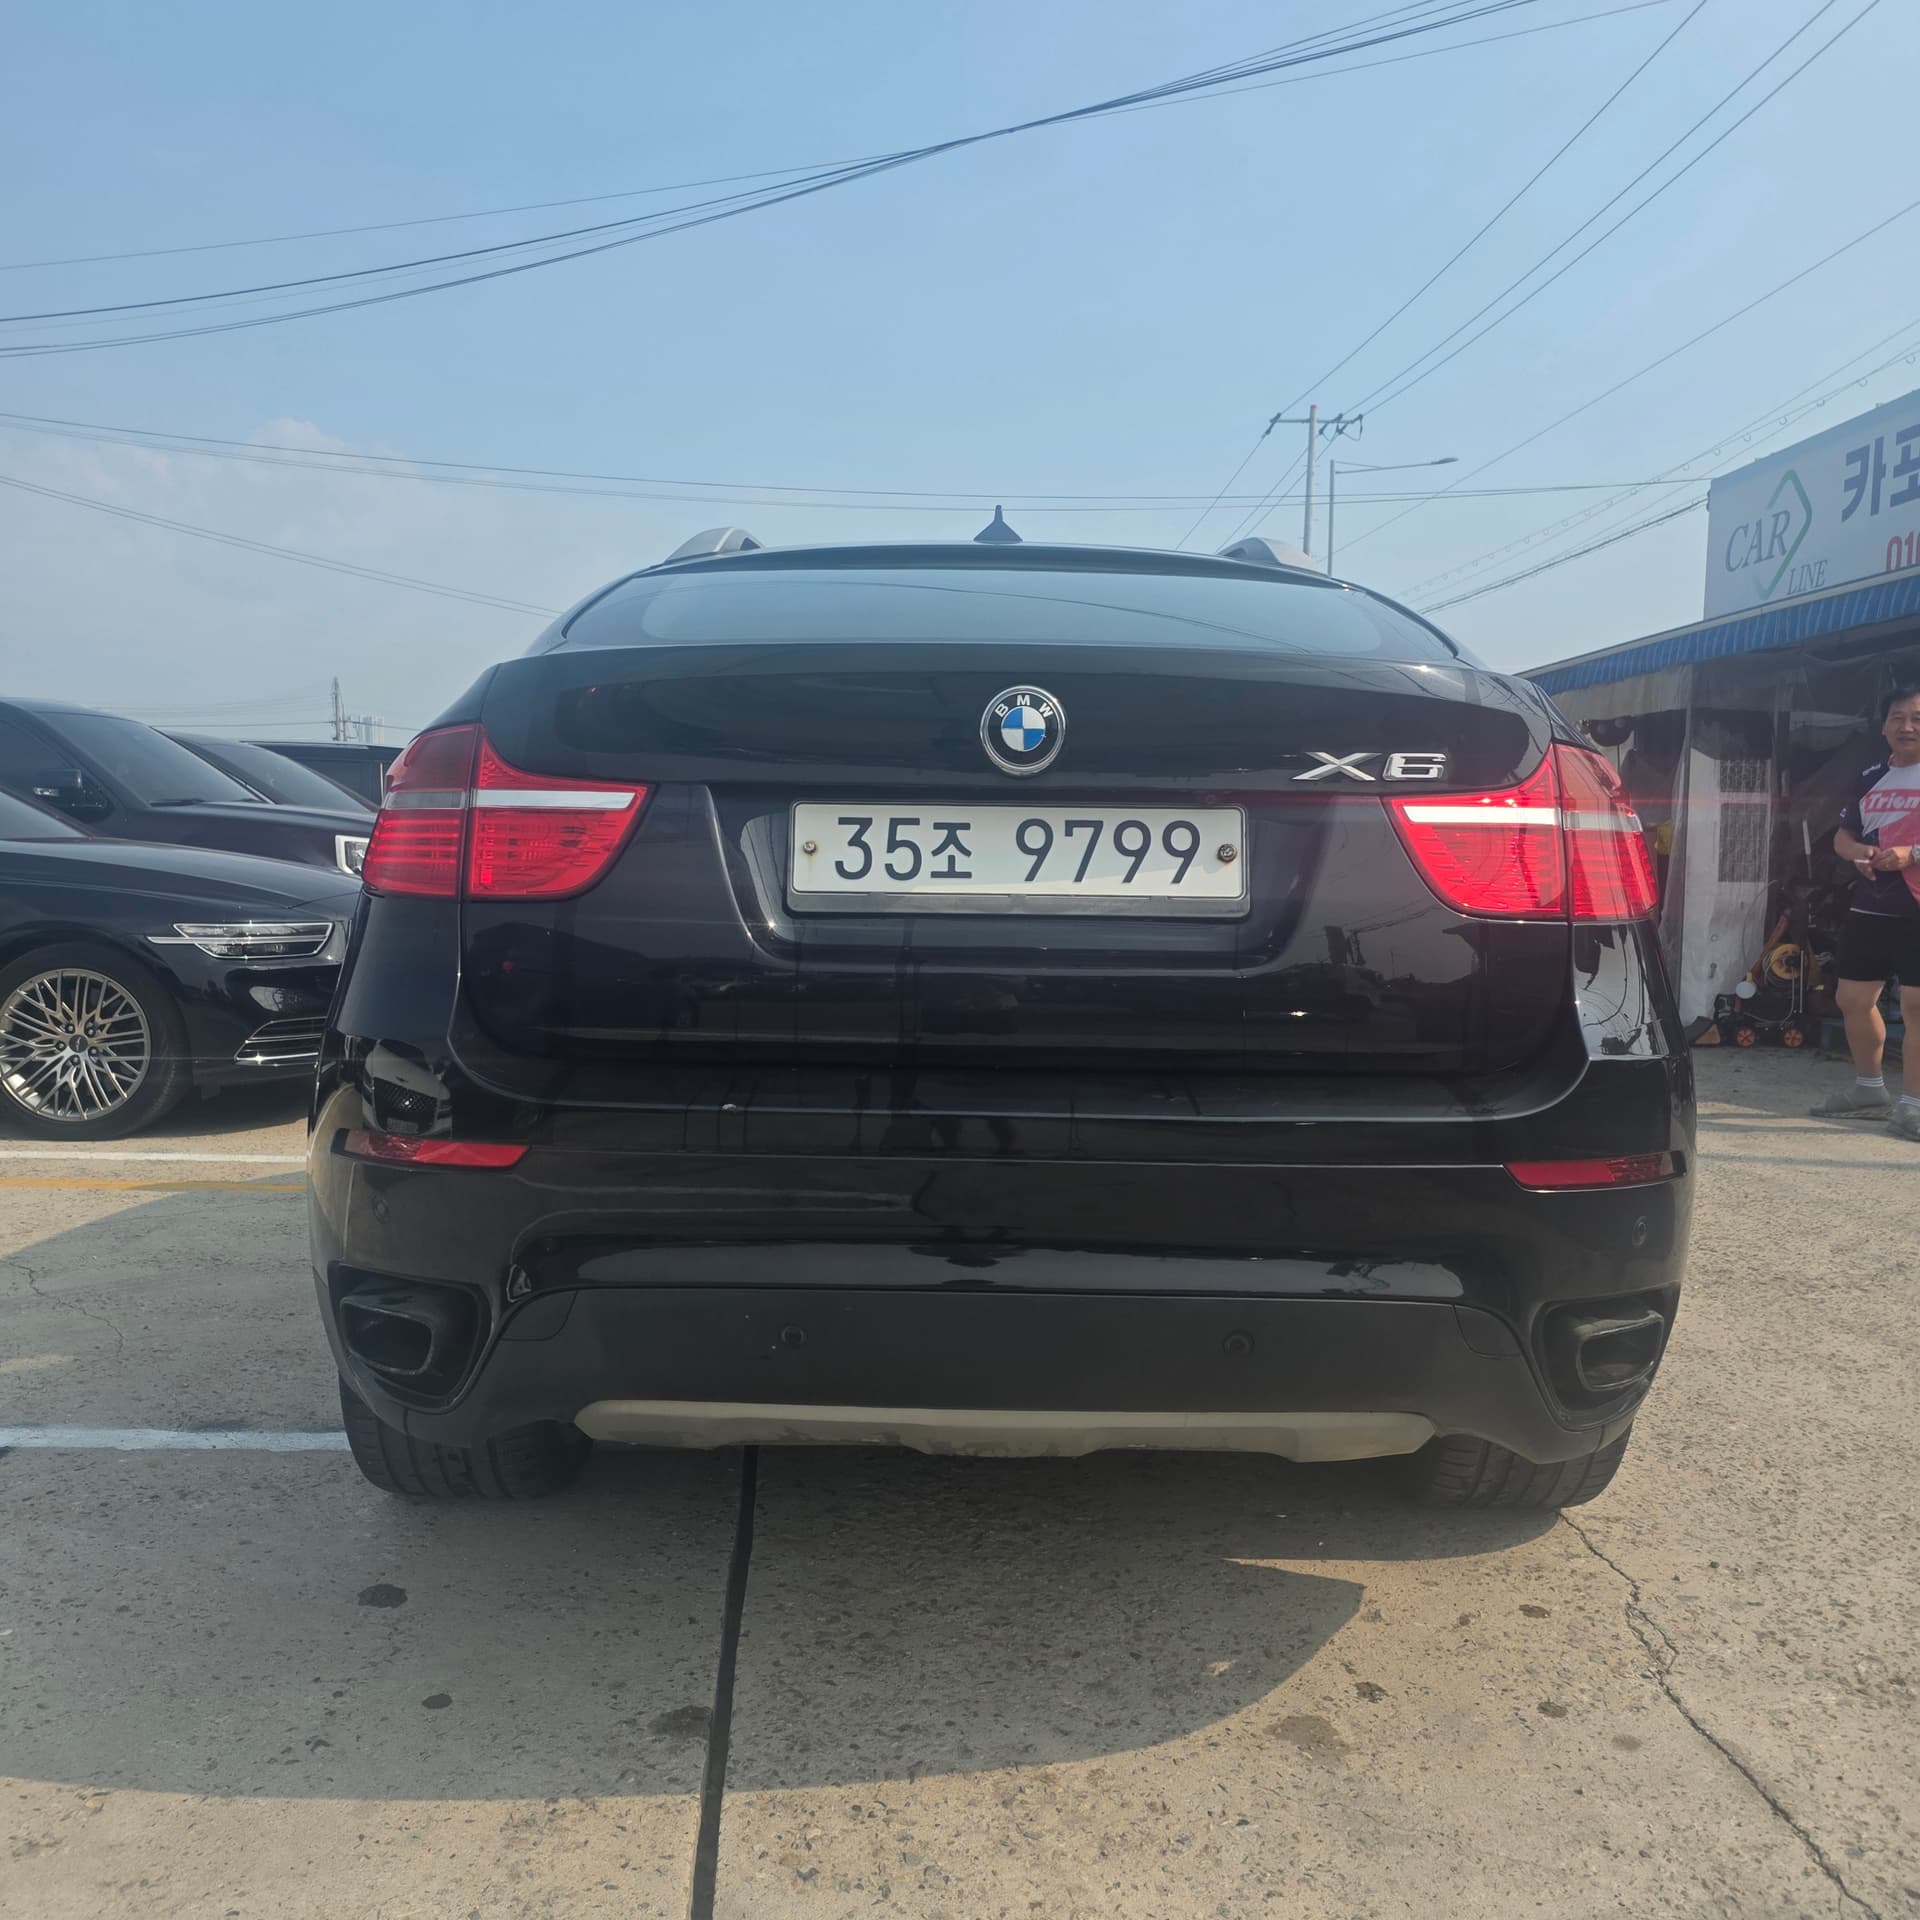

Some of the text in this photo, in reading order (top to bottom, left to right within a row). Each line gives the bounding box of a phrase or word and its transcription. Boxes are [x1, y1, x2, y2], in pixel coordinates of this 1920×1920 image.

[1725, 509, 1791, 573] CAR
[1886, 531, 1920, 572] 01
[1786, 559, 1828, 596] LINE
[995, 694, 1054, 718] BMW
[1292, 752, 1447, 781] X6
[835, 817, 1201, 884] 35조 9799
